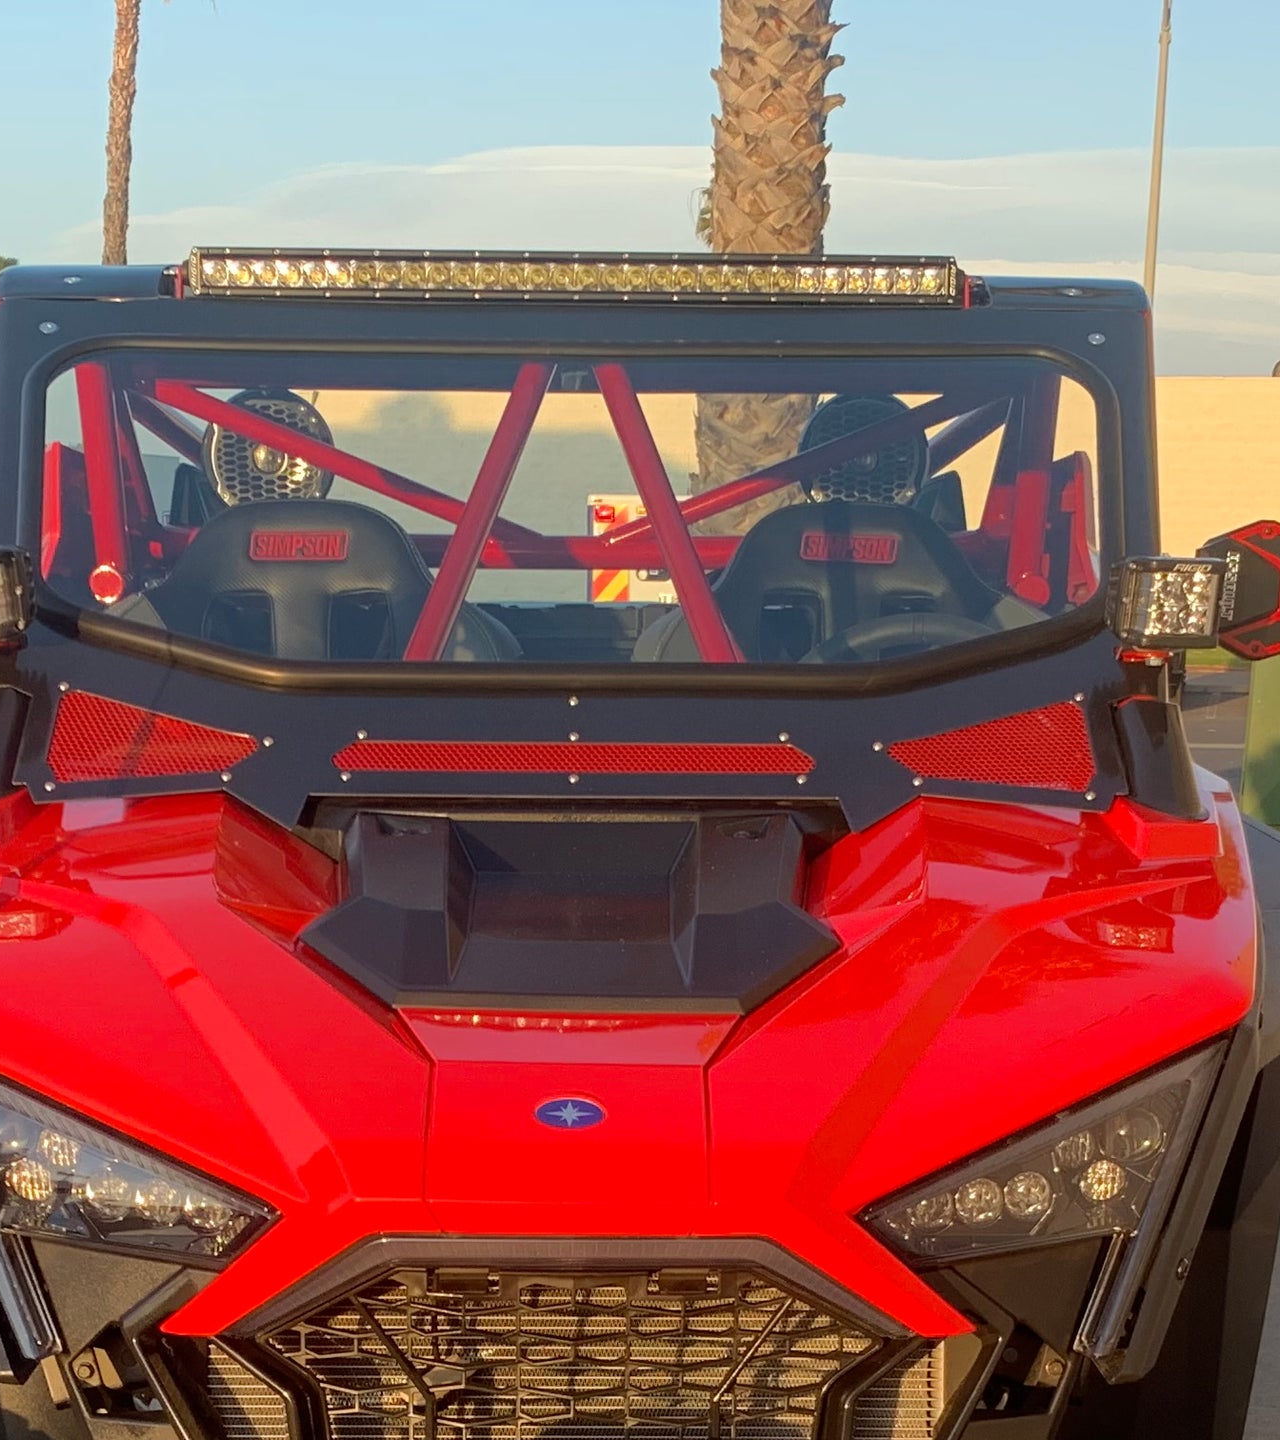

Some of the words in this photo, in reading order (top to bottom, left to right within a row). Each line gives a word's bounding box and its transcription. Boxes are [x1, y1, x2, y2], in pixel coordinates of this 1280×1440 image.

[256, 535, 341, 557] SIMPSON
[806, 536, 892, 560] SIMPSON
[1173, 563, 1213, 573] RIGID
